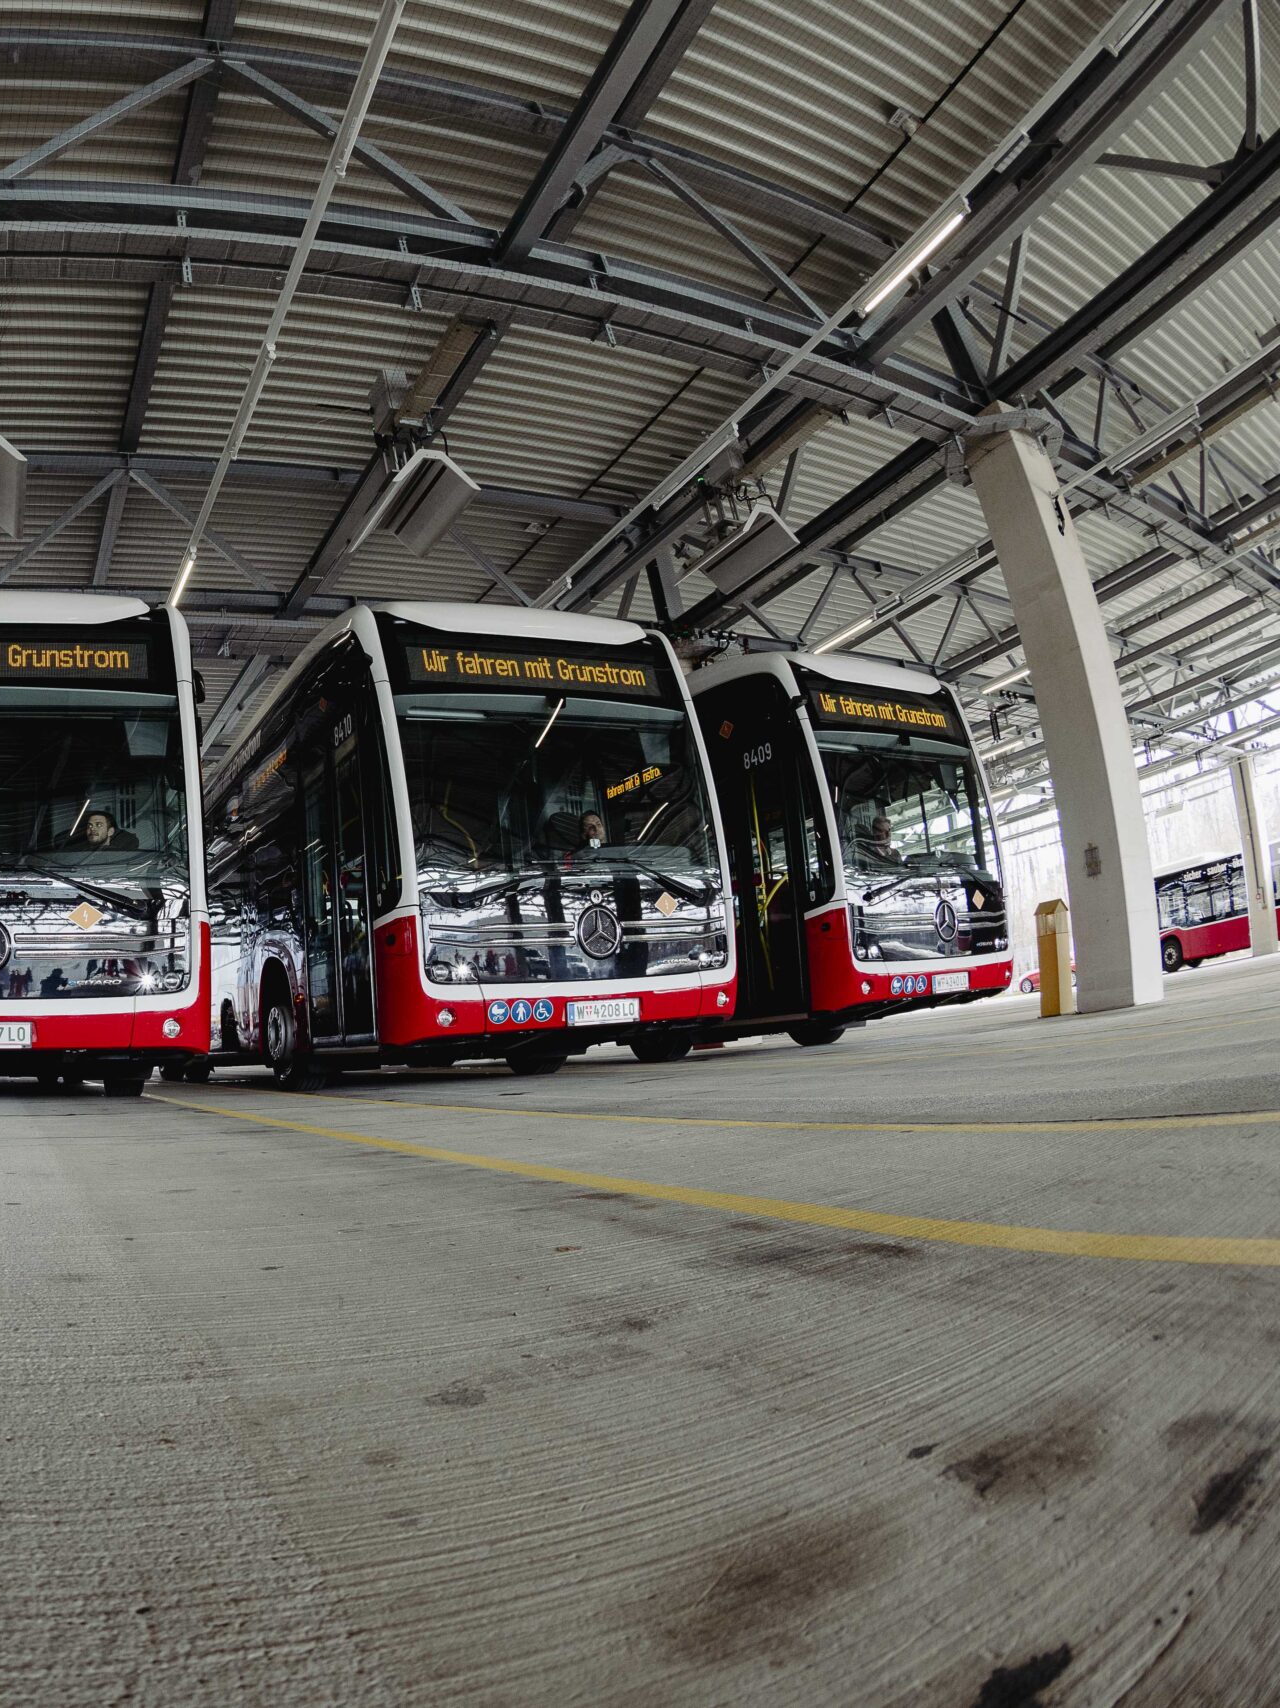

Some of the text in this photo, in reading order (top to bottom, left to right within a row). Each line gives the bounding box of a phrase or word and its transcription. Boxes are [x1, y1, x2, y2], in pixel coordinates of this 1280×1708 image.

[422, 650, 448, 673] Wir
[456, 652, 520, 677] fahren
[524, 658, 553, 680] mit
[820, 693, 836, 713] Wir
[840, 697, 877, 718] fahren
[878, 703, 895, 721] mit
[334, 713, 352, 747] 8410
[743, 742, 772, 769] 8409
